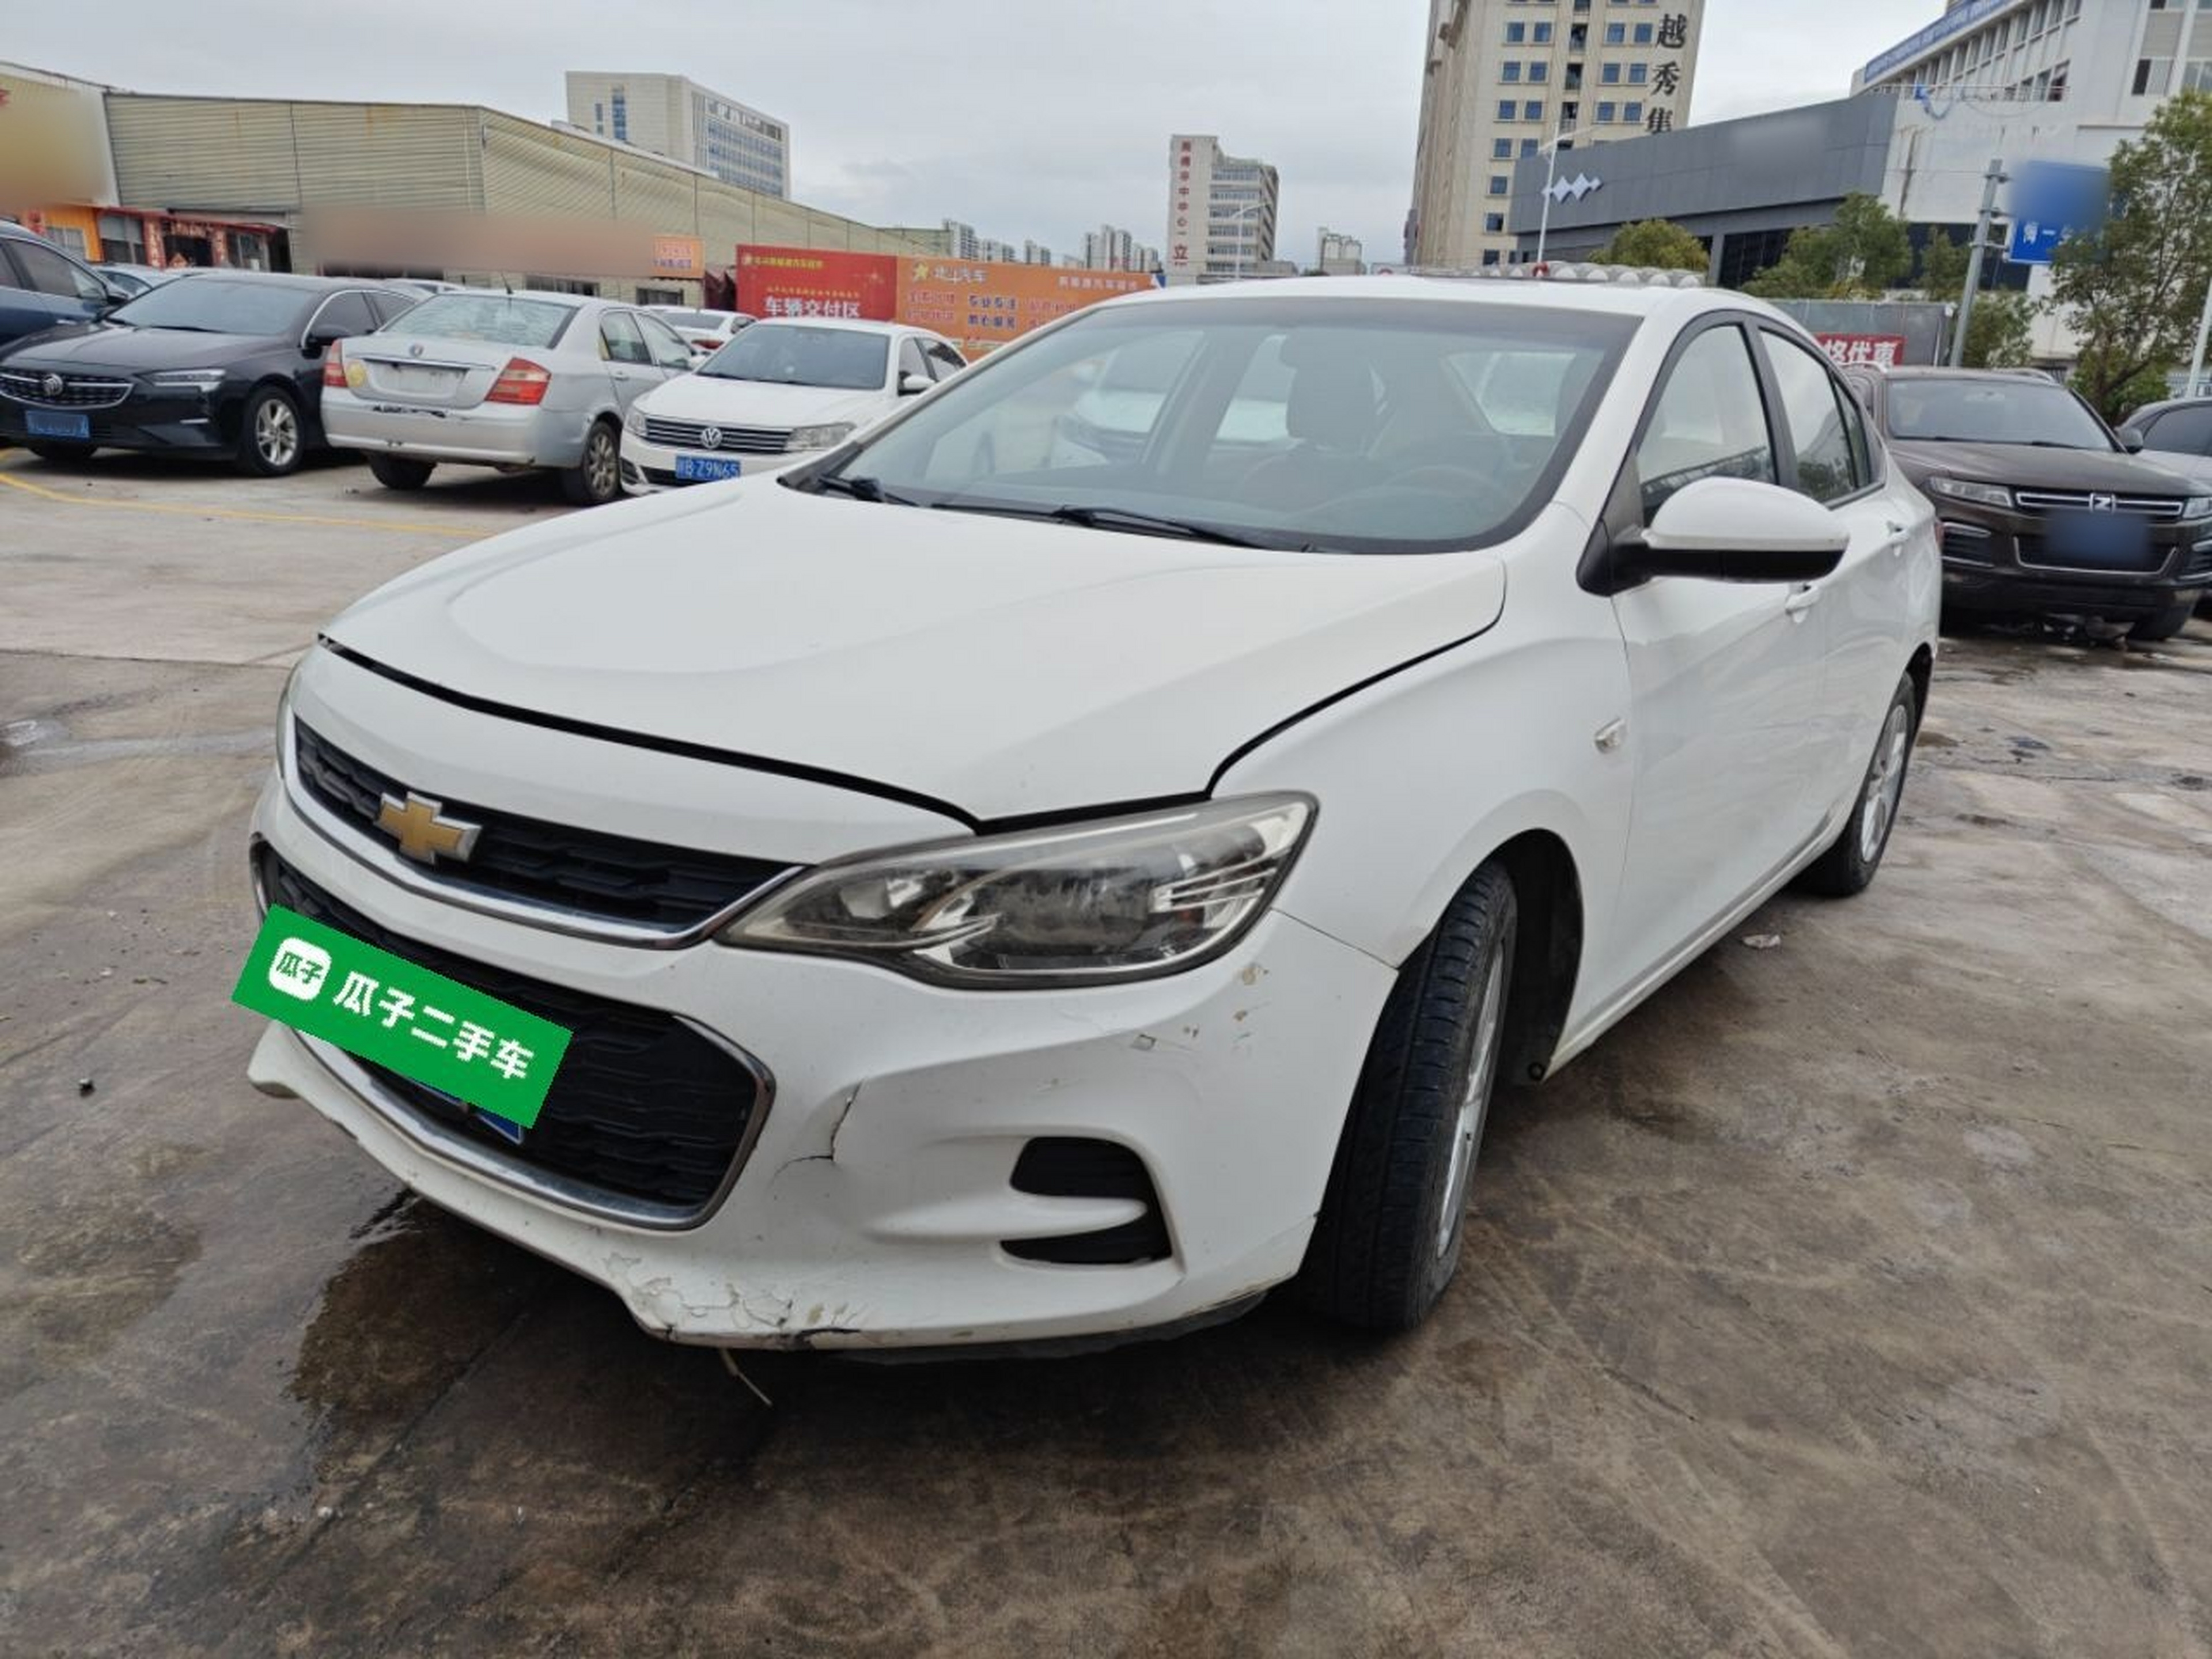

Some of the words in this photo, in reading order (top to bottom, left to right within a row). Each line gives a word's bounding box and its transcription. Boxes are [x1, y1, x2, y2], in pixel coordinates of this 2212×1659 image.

[764, 296, 861, 318] 车辆交付区
